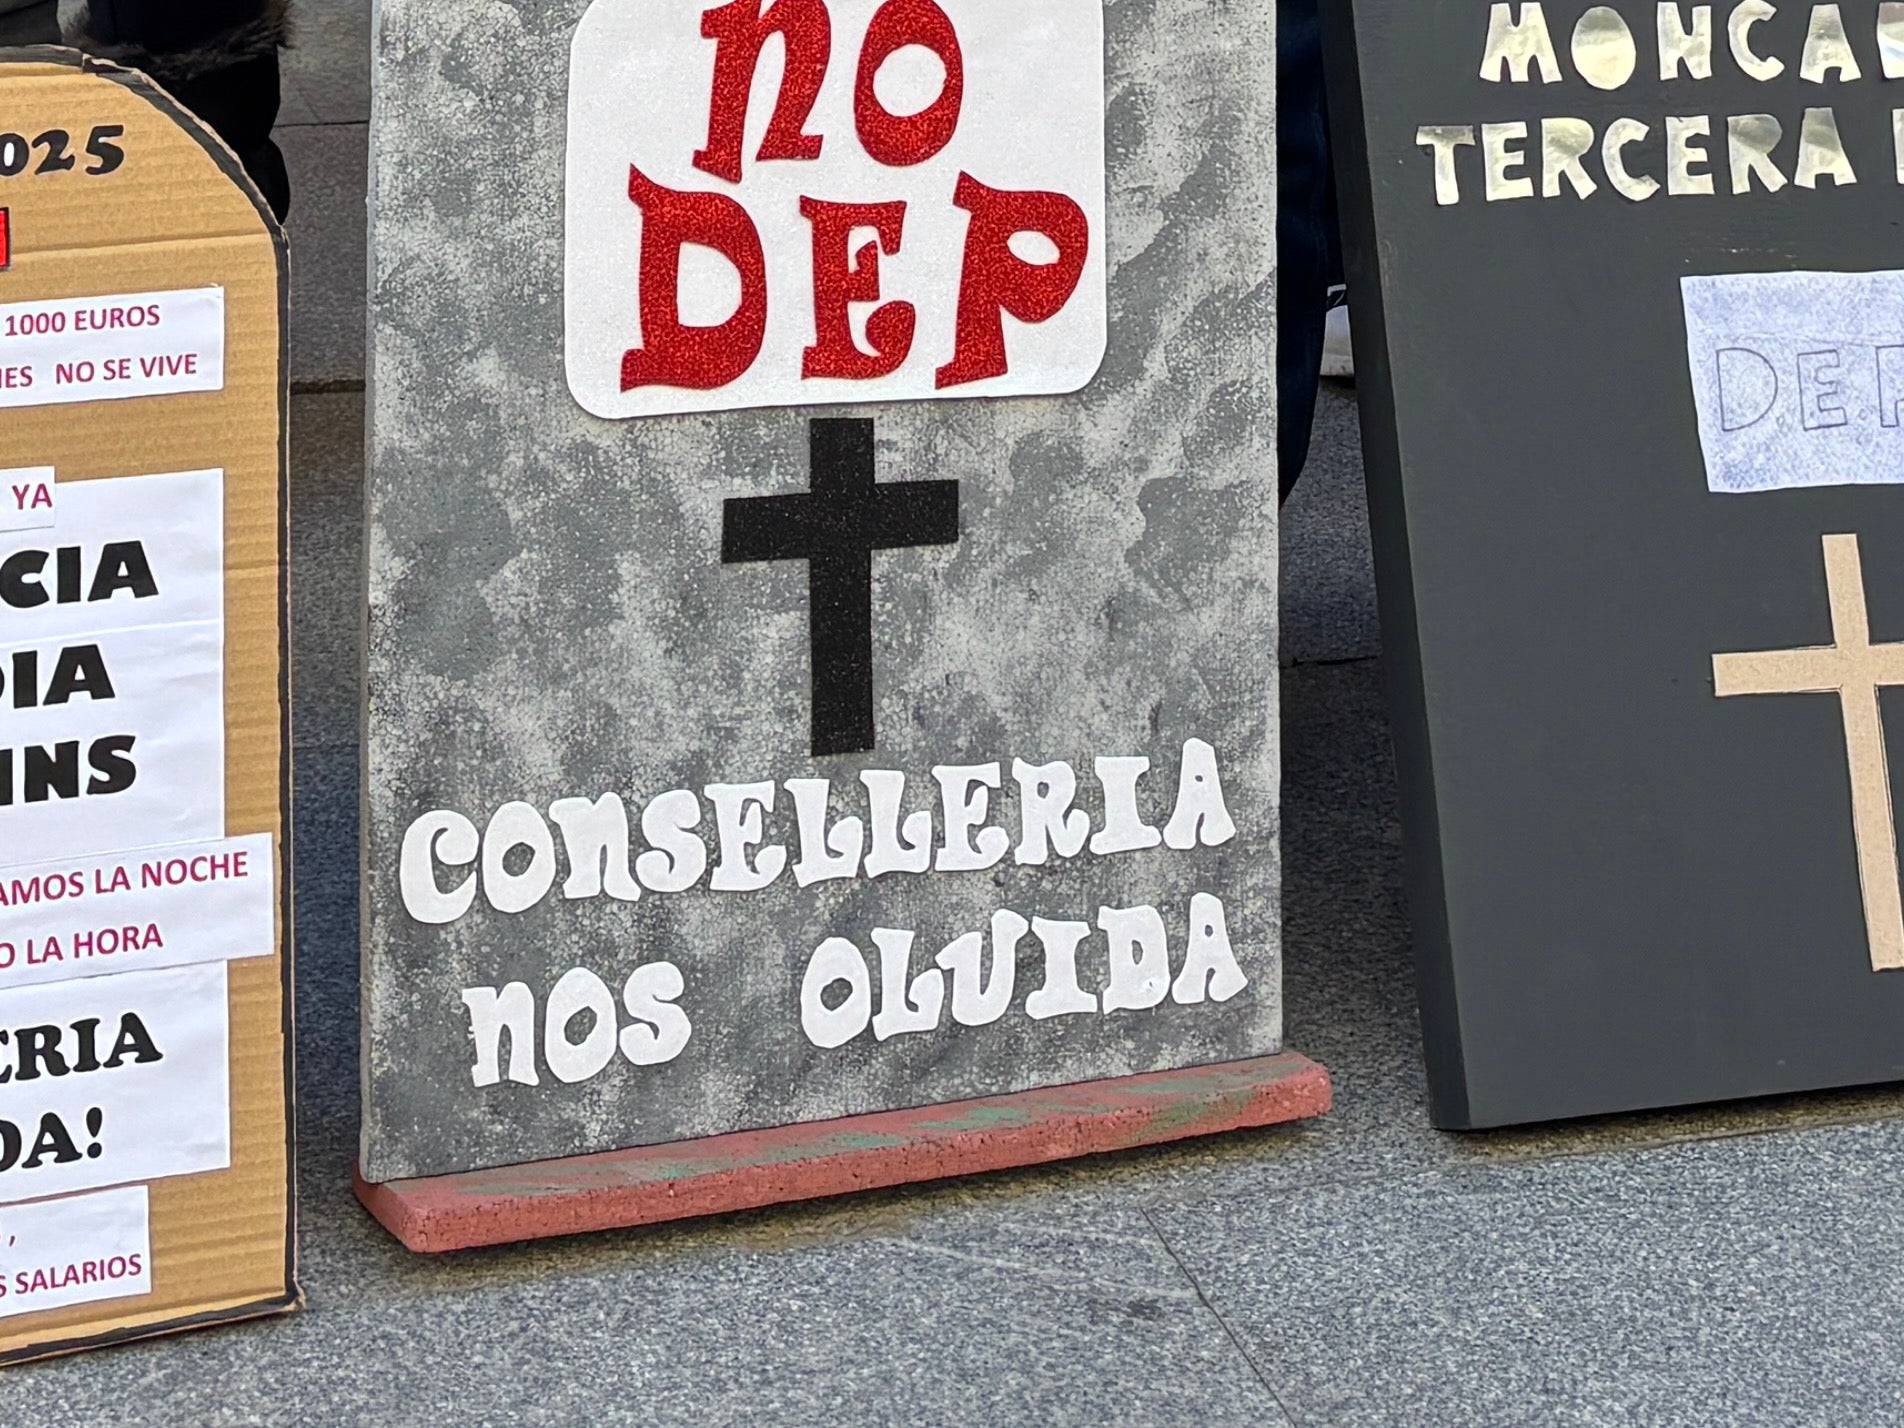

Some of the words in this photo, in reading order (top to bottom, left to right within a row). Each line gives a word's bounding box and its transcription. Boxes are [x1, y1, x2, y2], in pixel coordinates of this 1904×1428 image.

[1415, 107, 1858, 206] TERCERA
[619, 162, 1090, 393] DEP
[8, 312, 65, 335] 1000
[75, 306, 159, 330] EUROS
[57, 362, 94, 382] NO
[104, 360, 128, 379] SE
[141, 355, 195, 376] VIVE
[13, 484, 51, 509] YA
[399, 737, 1238, 925] CONSELLERIA
[96, 867, 130, 893] LA
[142, 853, 245, 887] NOCHE
[28, 937, 63, 964] LA
[74, 924, 162, 957] HORA
[462, 960, 693, 1089] NOS
[17, 1256, 141, 1293] SALARIOS
